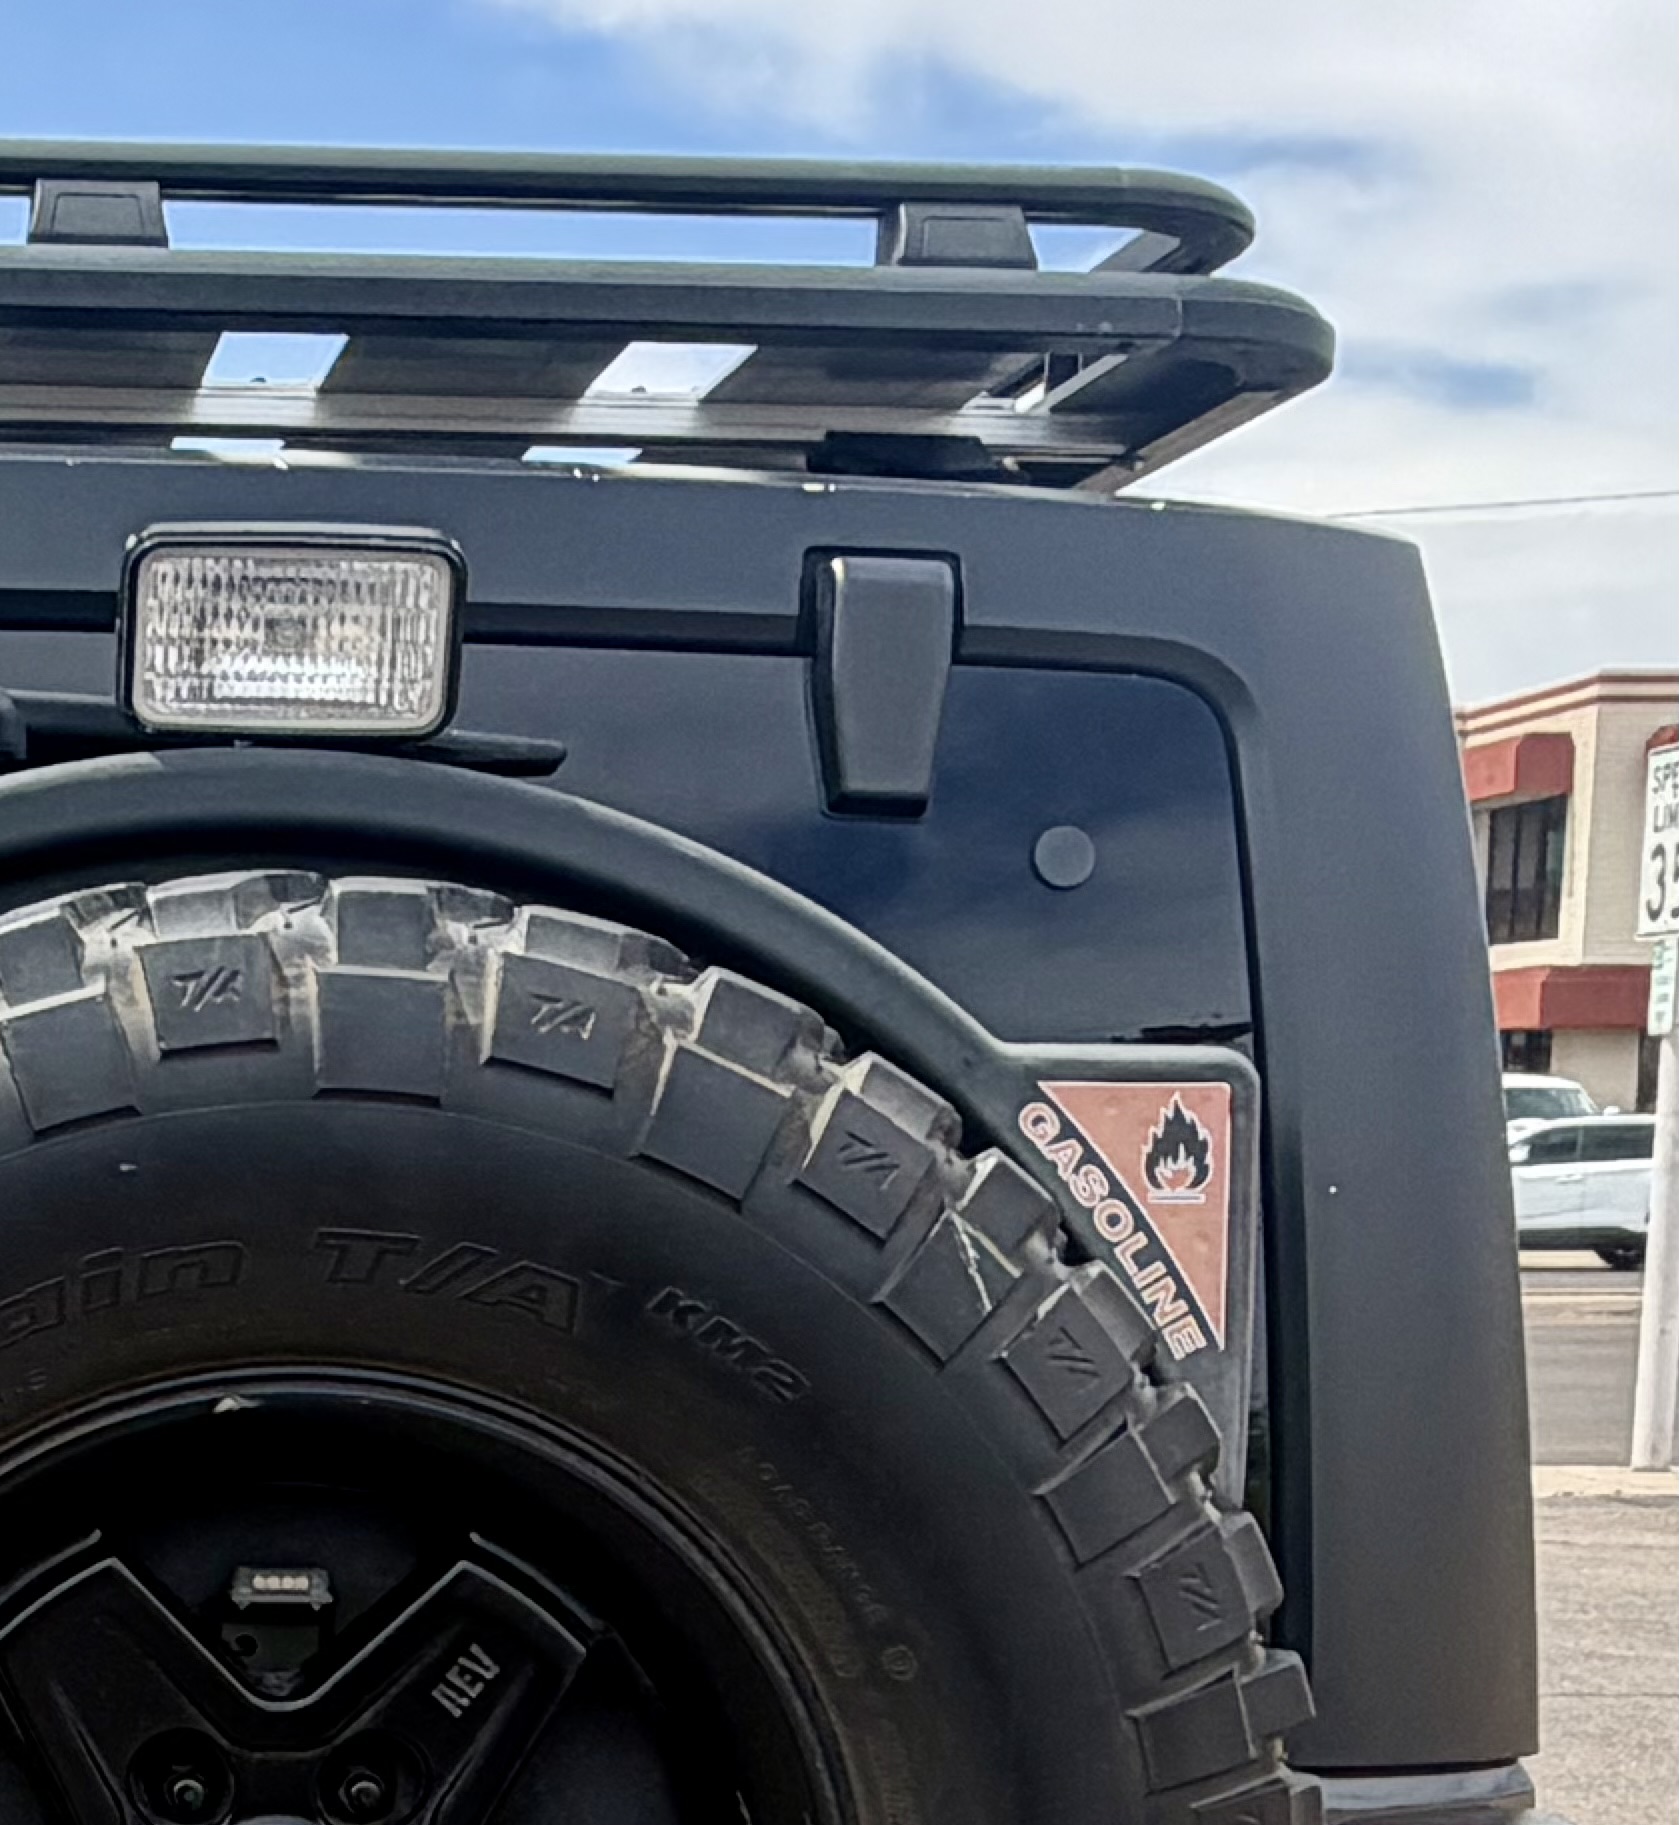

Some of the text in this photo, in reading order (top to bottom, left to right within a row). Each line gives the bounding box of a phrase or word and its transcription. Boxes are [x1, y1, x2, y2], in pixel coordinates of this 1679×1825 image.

[316, 1227, 582, 1335] T/A
[646, 1286, 812, 1402] KM2
[1019, 1102, 1207, 1361] GASOLINE
[431, 1642, 500, 1718] AEV
